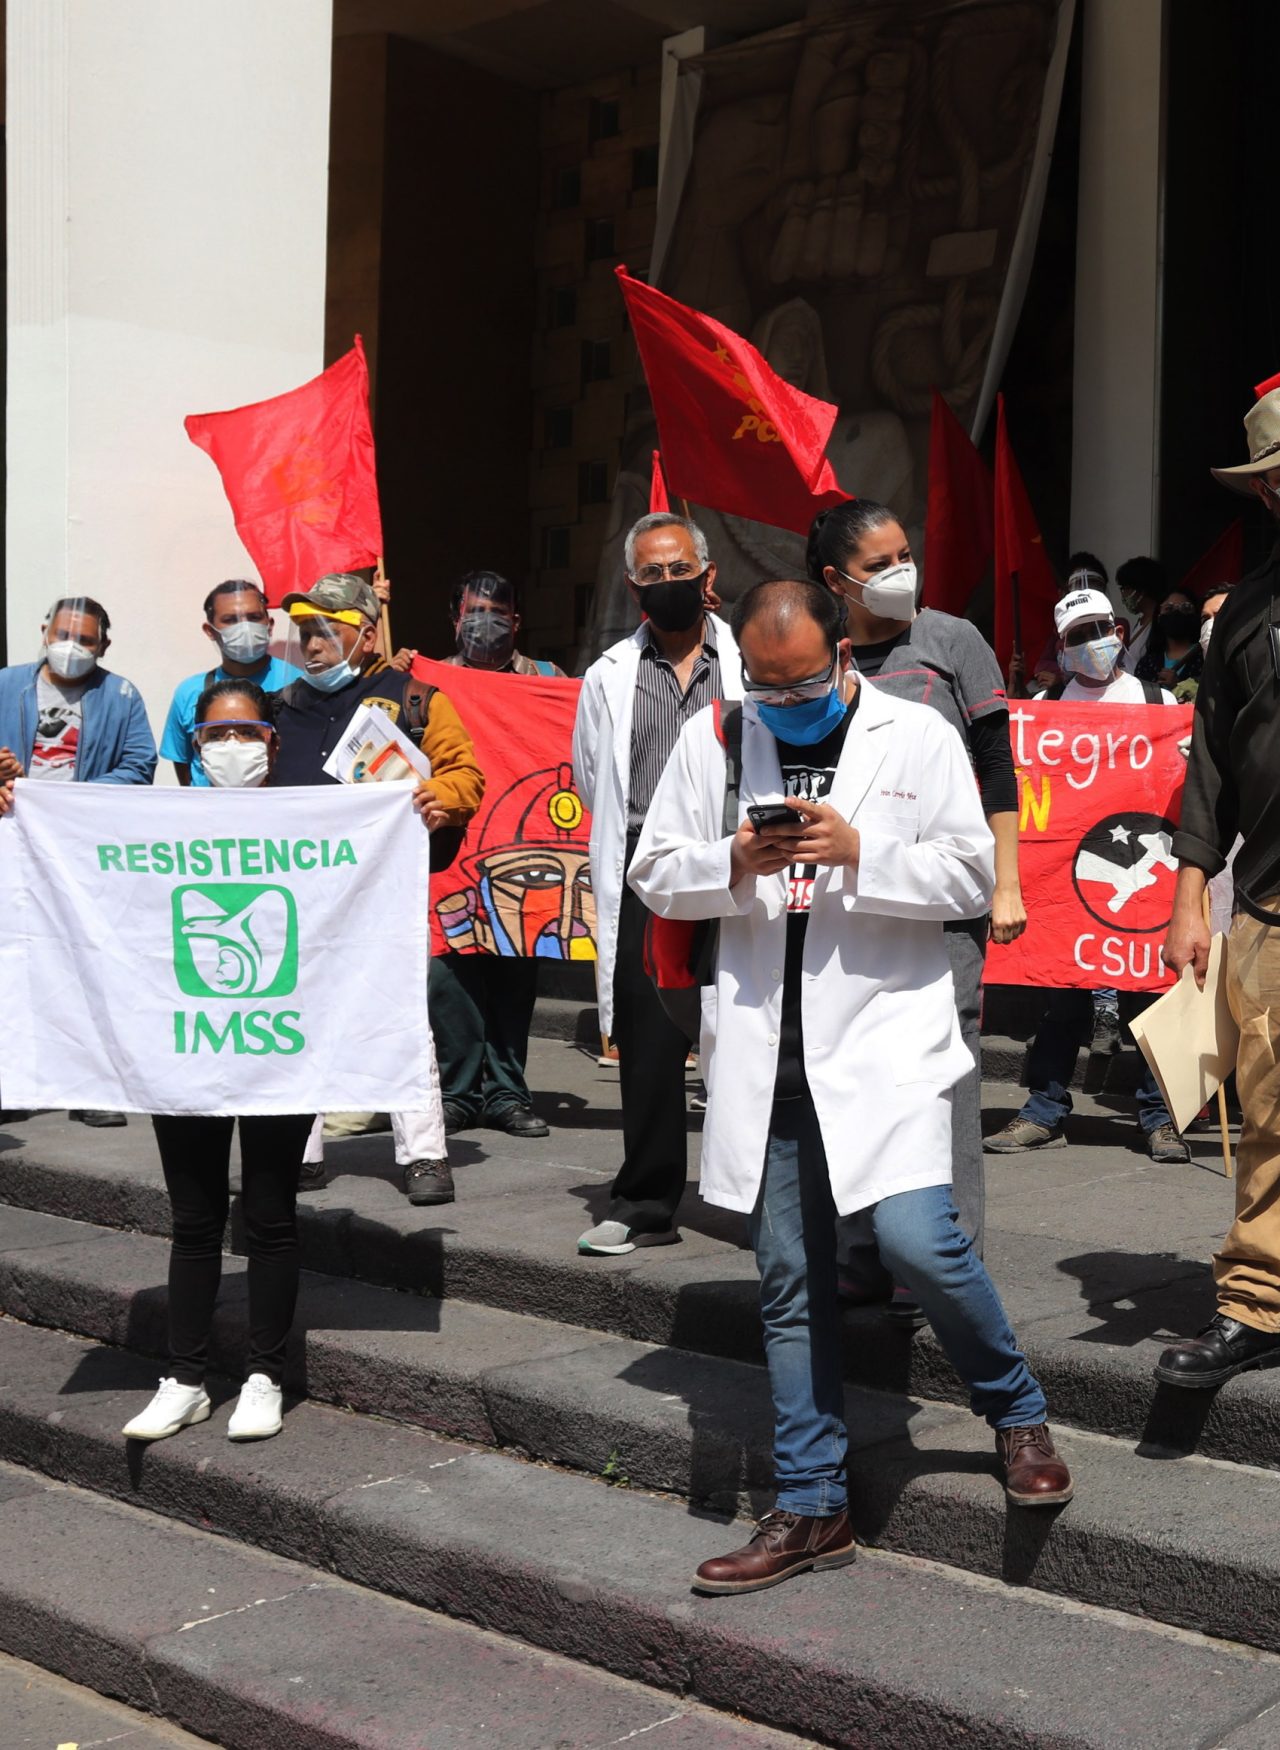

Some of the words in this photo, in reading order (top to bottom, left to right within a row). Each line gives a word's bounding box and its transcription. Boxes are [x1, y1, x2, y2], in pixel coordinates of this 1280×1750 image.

[1065, 596, 1088, 610] PUMA
[1009, 706, 1153, 790] tegro
[97, 838, 358, 876] RESISTENCIA
[174, 1010, 305, 1056] IMSS
